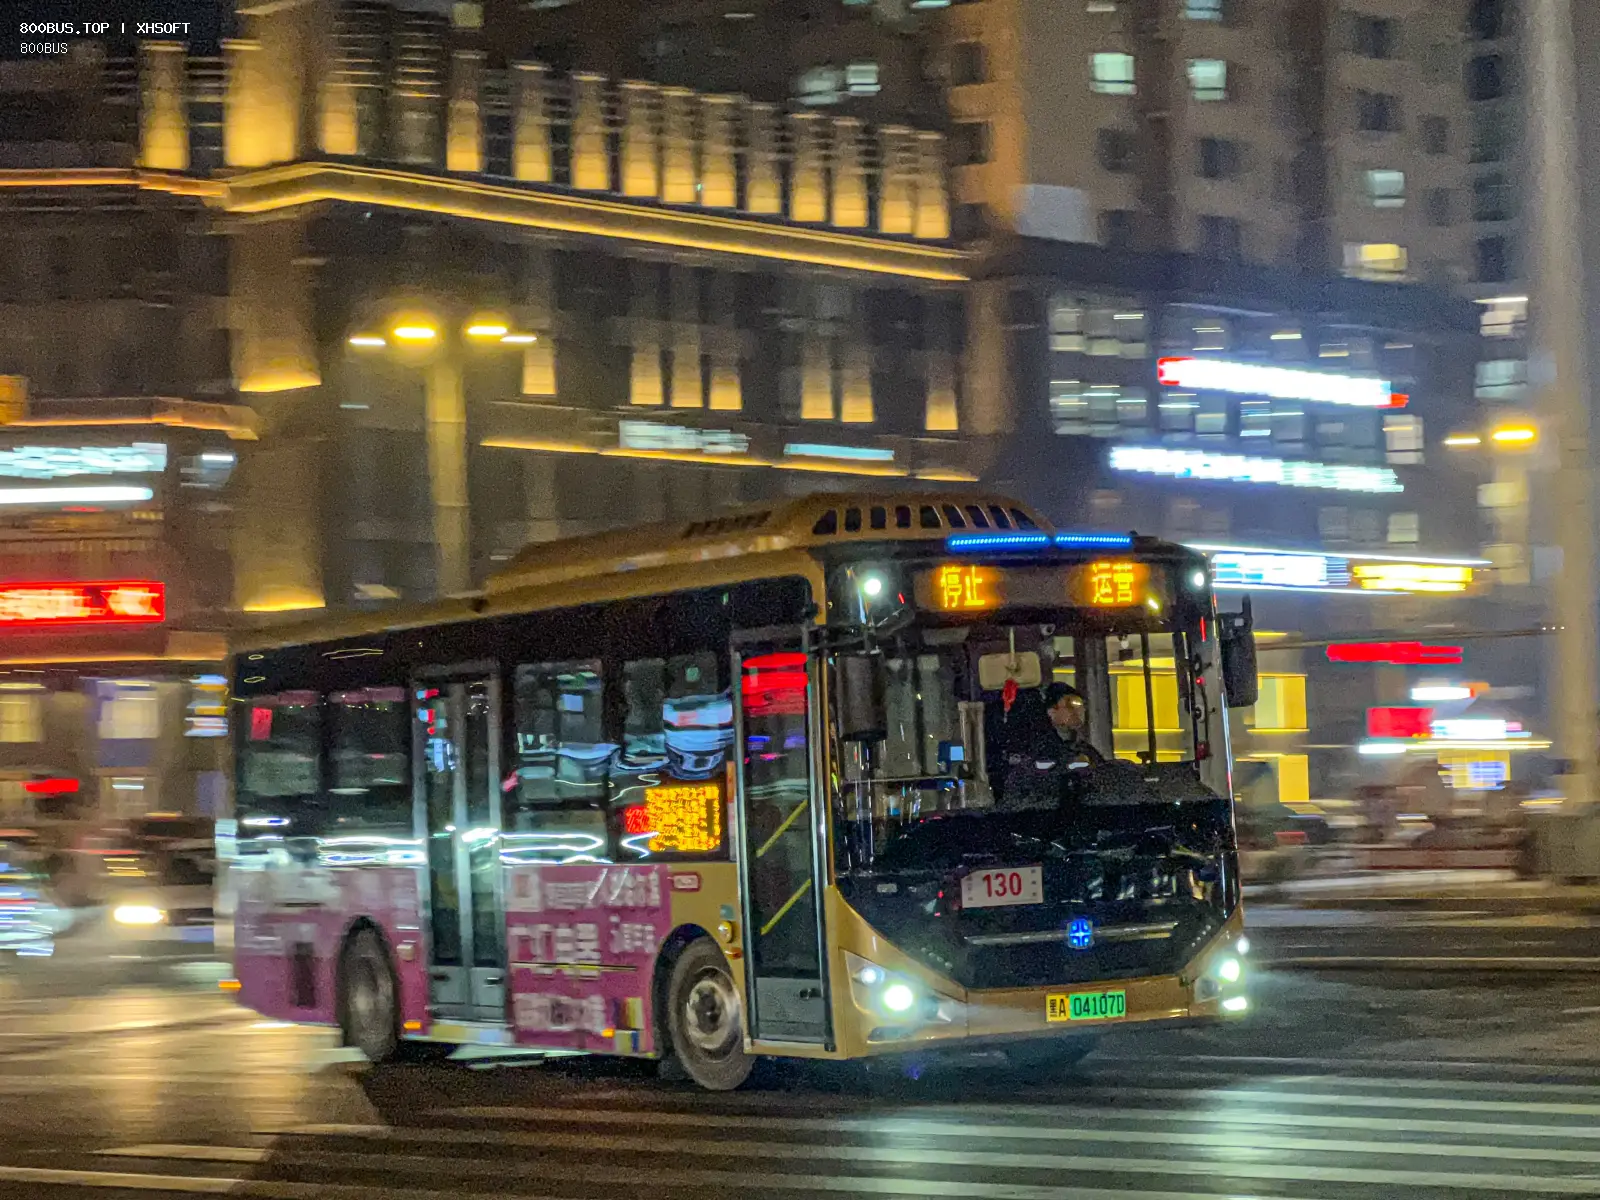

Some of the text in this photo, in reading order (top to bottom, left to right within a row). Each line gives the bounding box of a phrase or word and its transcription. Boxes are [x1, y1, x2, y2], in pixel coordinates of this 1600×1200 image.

[940, 562, 1134, 609] 停止 运营
[982, 871, 1022, 898] 130
